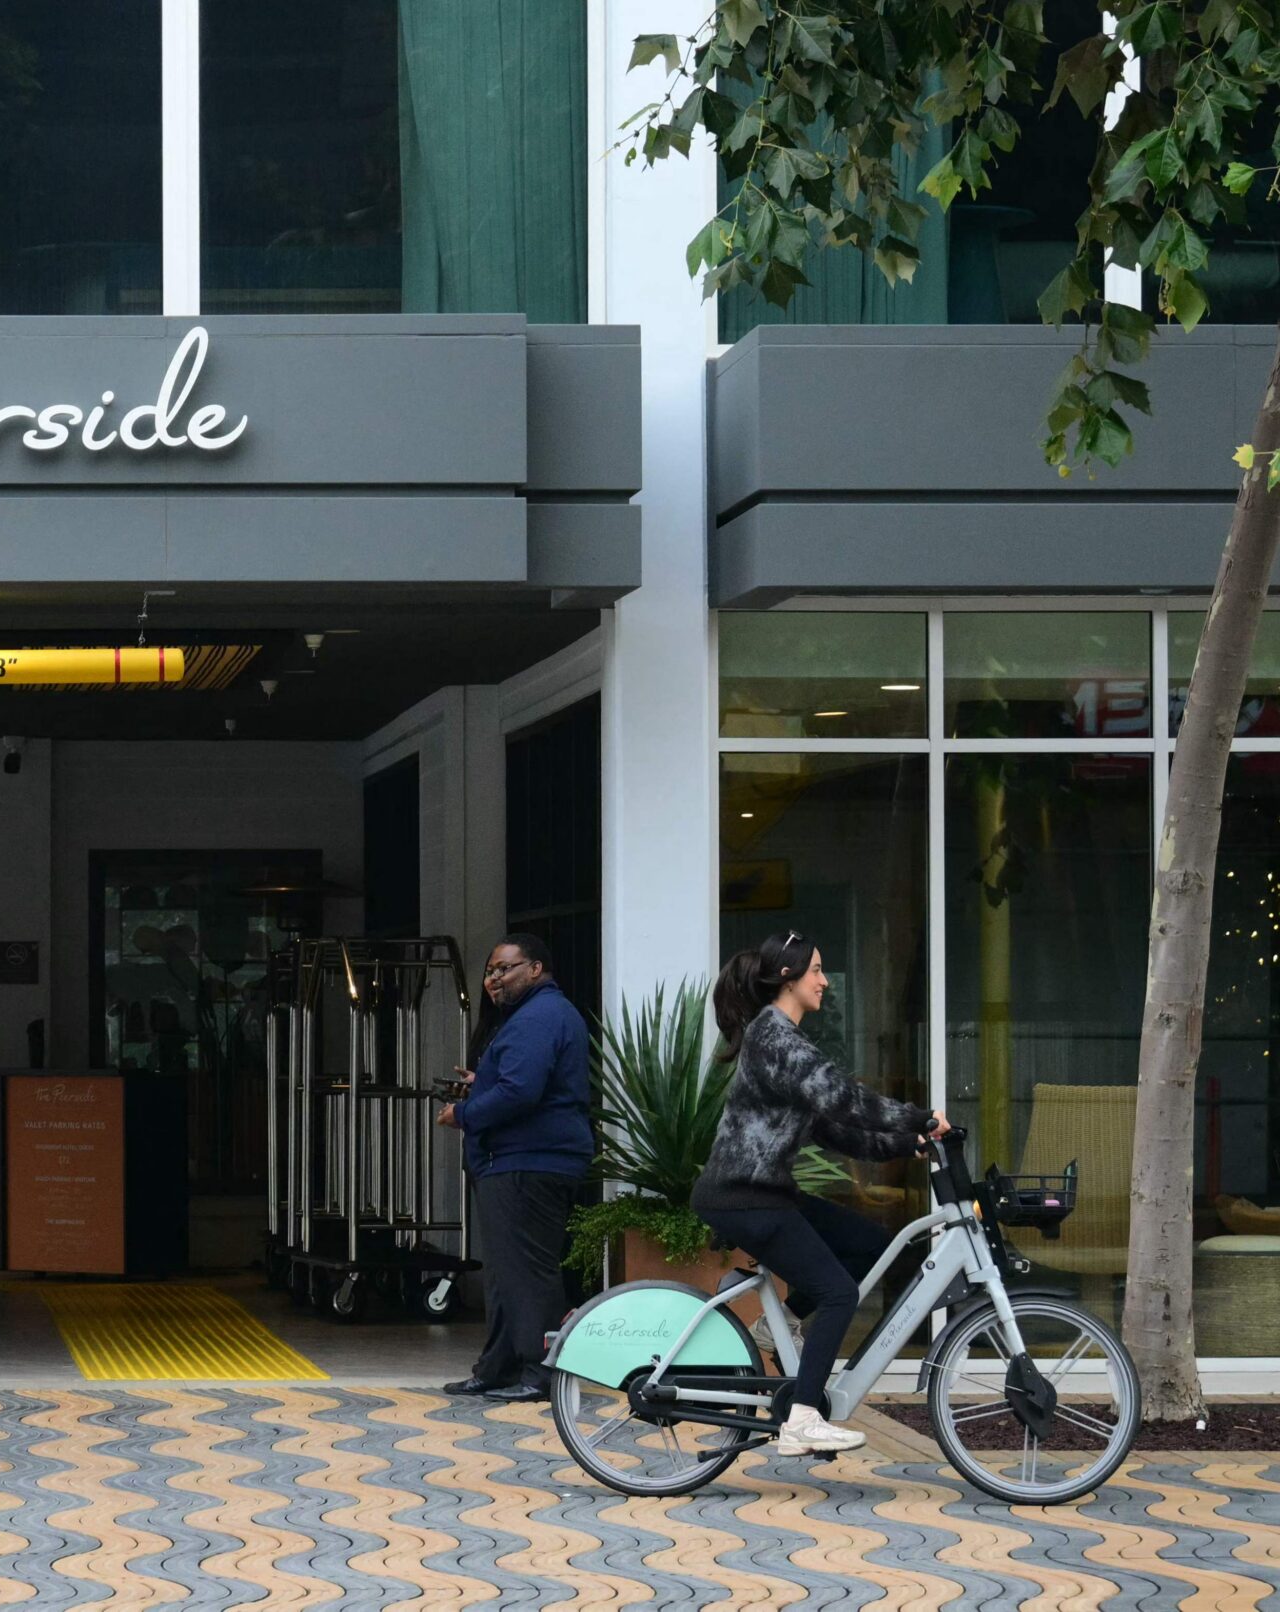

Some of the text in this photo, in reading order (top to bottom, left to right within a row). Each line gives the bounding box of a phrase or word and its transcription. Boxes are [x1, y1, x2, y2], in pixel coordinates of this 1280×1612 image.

[24, 1120, 106, 1130] VALET PARKING RATES
[607, 1317, 672, 1340] Pierside
